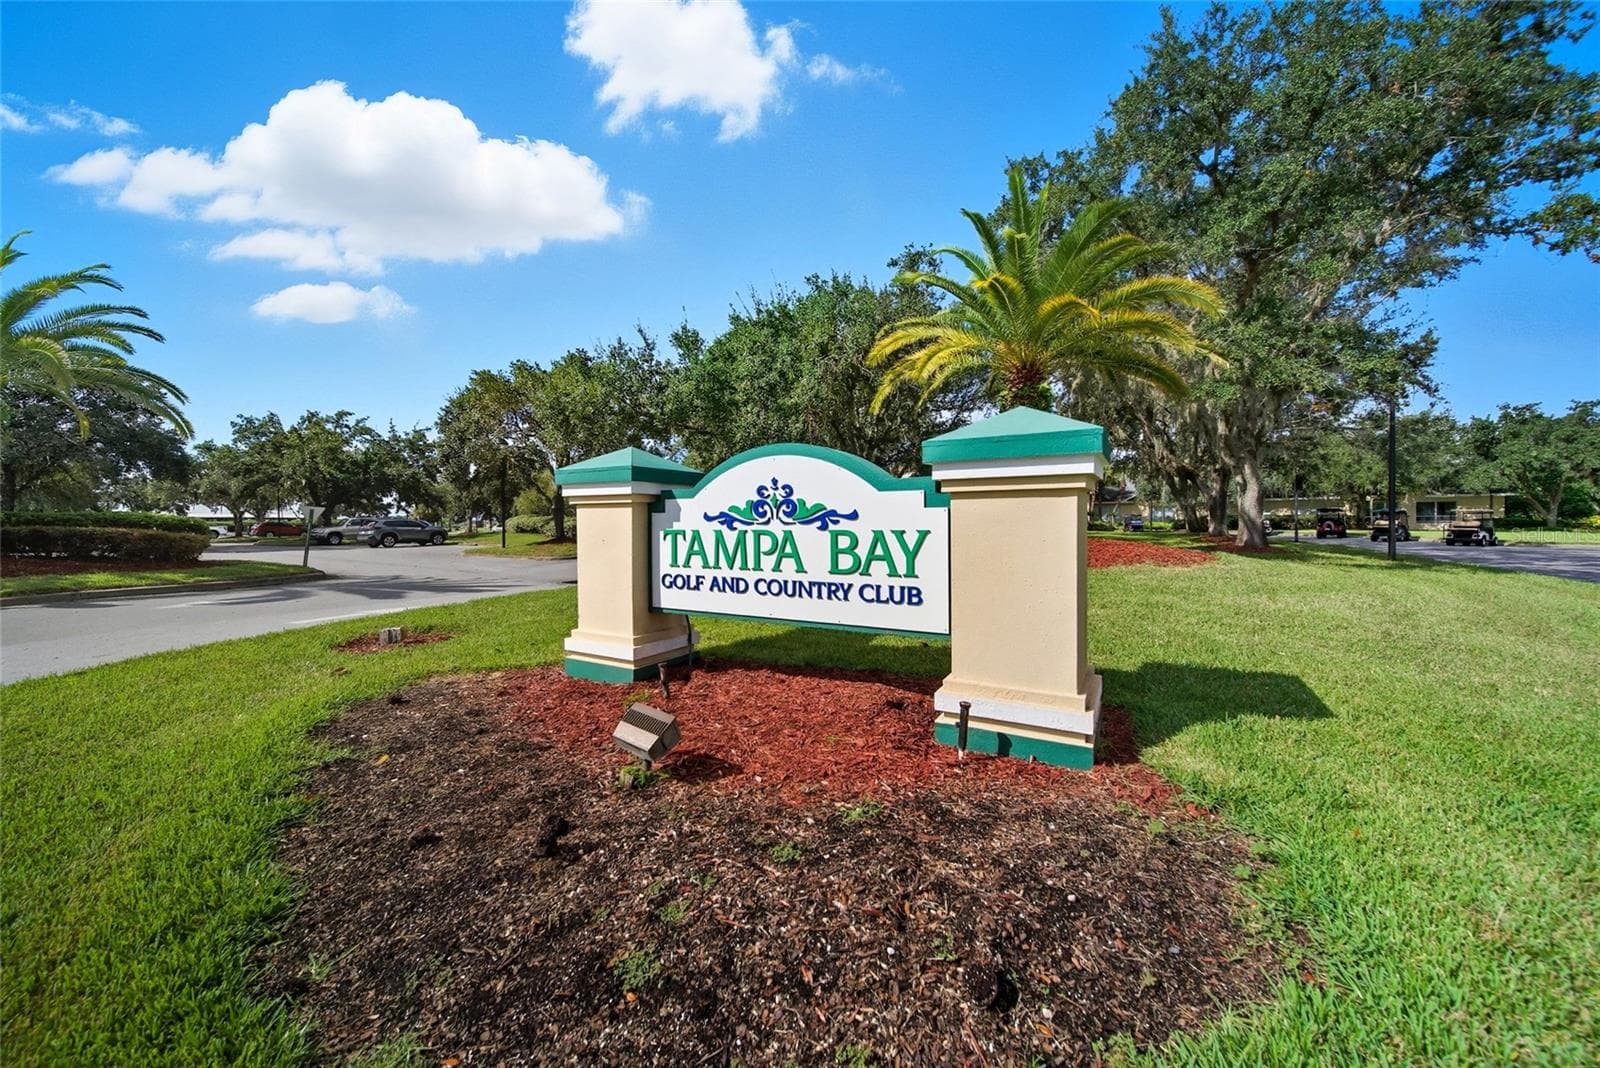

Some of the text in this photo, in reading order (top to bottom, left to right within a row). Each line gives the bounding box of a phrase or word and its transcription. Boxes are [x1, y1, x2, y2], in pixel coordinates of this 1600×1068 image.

[663, 529, 931, 578] TAMPA BAY
[661, 573, 924, 607] GOLF AND COUNTRY CLUB
